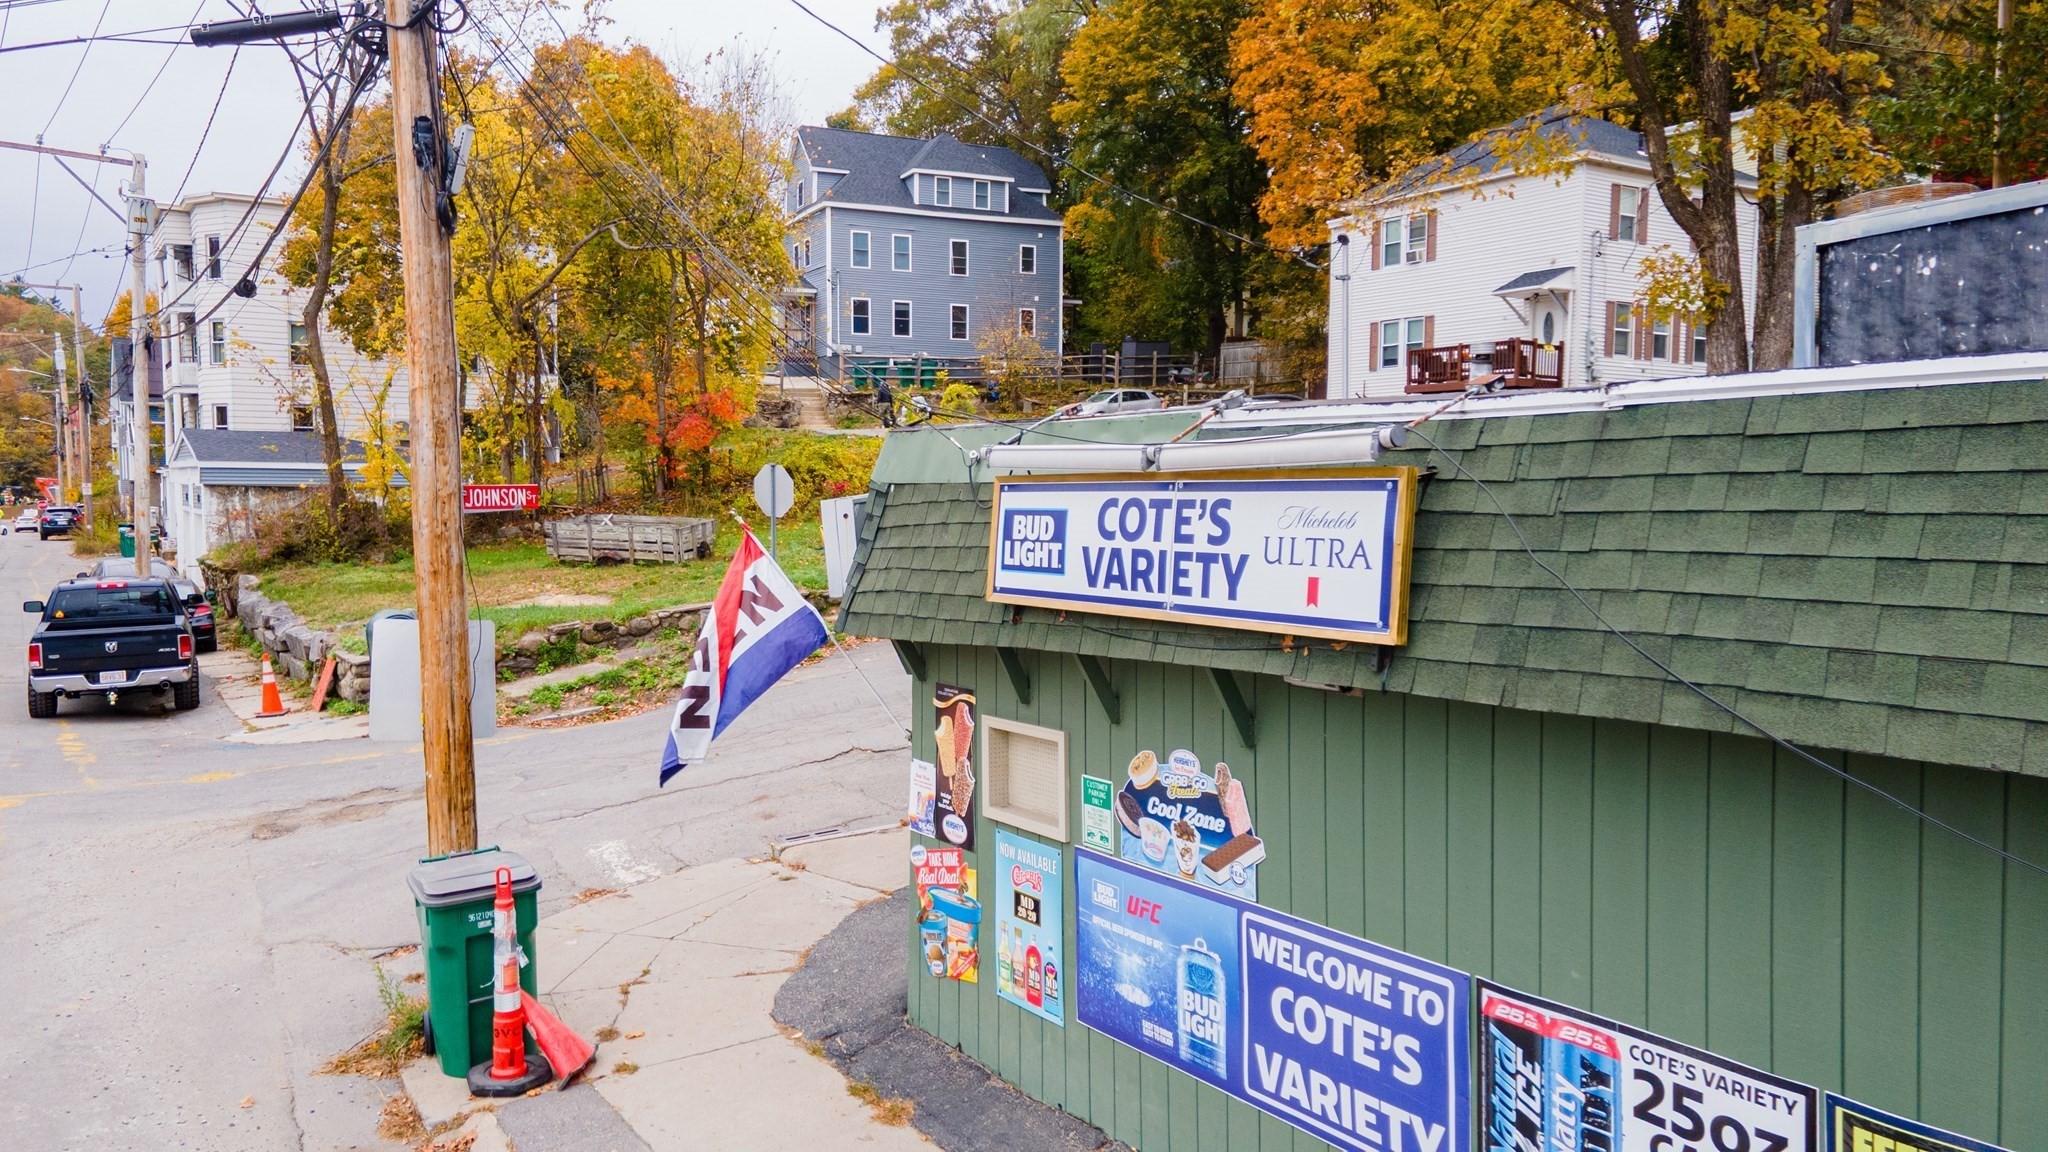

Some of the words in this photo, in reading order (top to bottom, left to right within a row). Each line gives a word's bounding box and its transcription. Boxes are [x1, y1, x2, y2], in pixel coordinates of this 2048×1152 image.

[465, 488, 527, 507] JOHNSON
[527, 491, 536, 504] ST
[1012, 514, 1055, 541] BUD
[1097, 497, 1232, 547] COTE'S
[1277, 505, 1359, 530] Michelob
[1003, 540, 1062, 569] LIGHT
[1264, 535, 1373, 570] ULTRA
[1081, 545, 1250, 602] VARIETY
[1086, 780, 1108, 792] CUSTOMER
[1088, 788, 1107, 800] PARKING
[1091, 797, 1104, 807] ONLY
[1147, 796, 1183, 821] Cool
[1183, 805, 1226, 833] Zone
[928, 852, 943, 867] TAKE
[942, 851, 960, 867] HOME
[1000, 842, 1016, 860] NOW
[1017, 849, 1057, 875] AVAILABLE
[918, 867, 938, 885] Real
[938, 867, 960, 885] Deal
[1230, 869, 1246, 880] REAL
[1020, 894, 1035, 910] MD
[1094, 891, 1118, 909] LIGHT
[1096, 883, 1114, 897] BUD
[1127, 895, 1163, 925] UFC
[1249, 928, 1392, 1010] WELCOME
[1398, 980, 1445, 1026] TO
[1183, 989, 1221, 1021] BUD
[1494, 1004, 1525, 1023] 25
[1271, 986, 1423, 1086] COTE'S
[1558, 1026, 1593, 1047] 25
[1516, 1045, 1542, 1129] ICE
[1629, 1044, 1697, 1081] COTE'S
[1702, 1068, 1798, 1116] VARIETY
[1254, 1043, 1446, 1152] VARIETY
